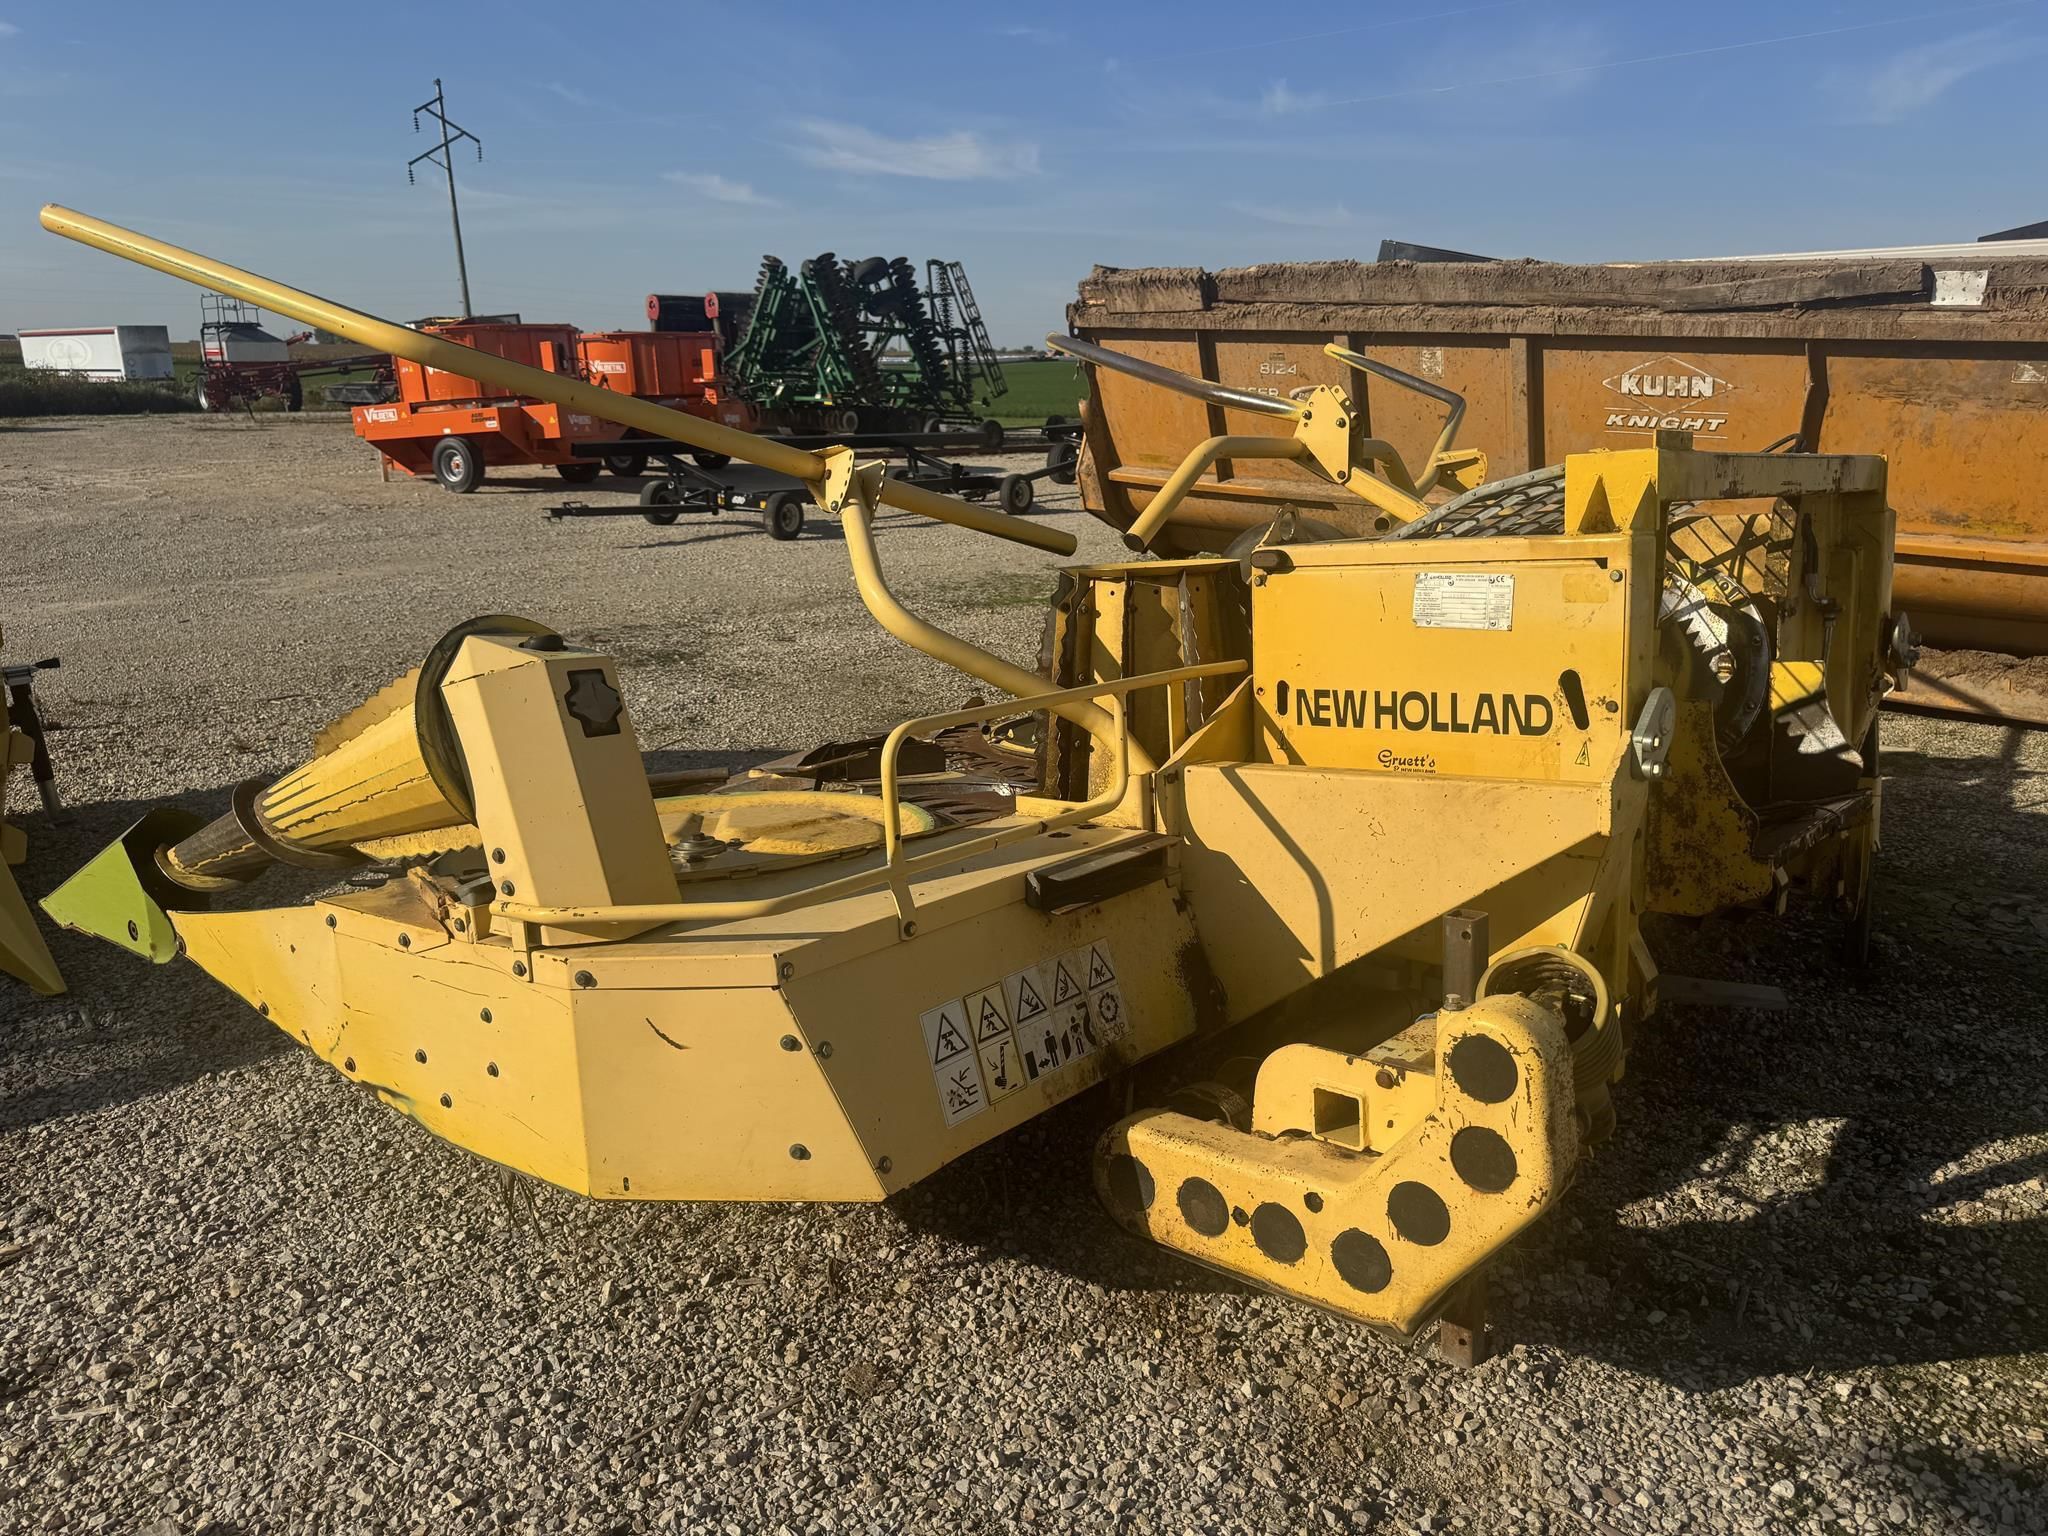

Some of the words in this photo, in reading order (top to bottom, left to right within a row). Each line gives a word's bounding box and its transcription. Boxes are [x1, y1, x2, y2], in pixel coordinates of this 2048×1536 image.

[1619, 374, 1714, 399] KUHN
[1606, 414, 1727, 432] KNIGHT
[1296, 688, 1368, 729] NEW
[1373, 690, 1554, 737] HOLLAND
[1378, 749, 1436, 768] Gruett's
